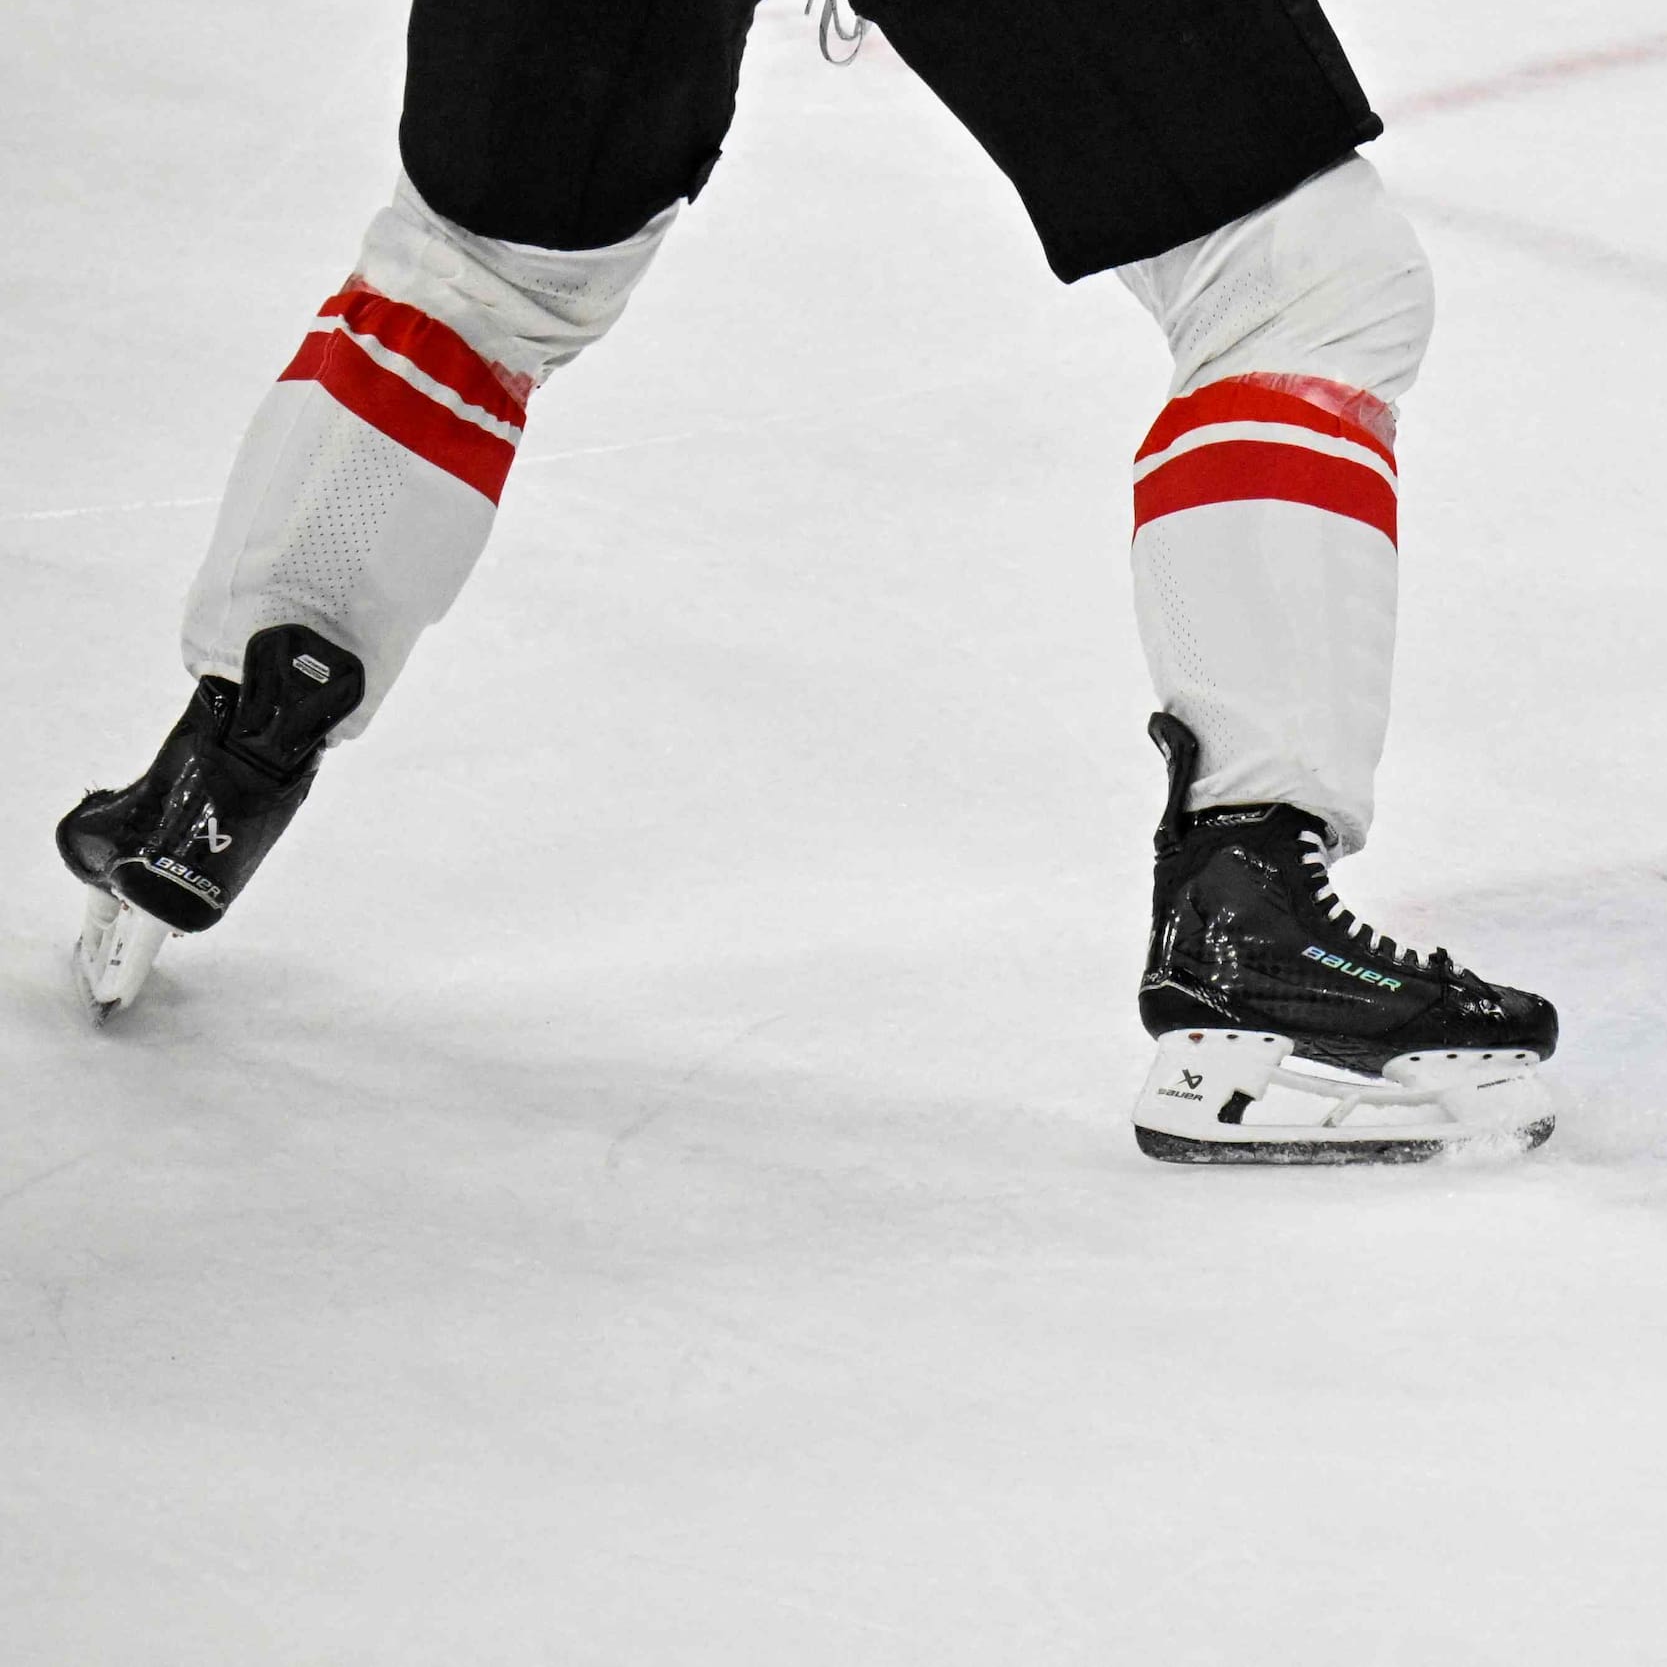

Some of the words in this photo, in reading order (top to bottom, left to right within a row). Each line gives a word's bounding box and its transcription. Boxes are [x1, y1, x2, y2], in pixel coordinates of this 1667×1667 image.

[154, 855, 222, 899] BAUER
[1301, 946, 1401, 992] BAUER
[1158, 1088, 1203, 1101] BAUER
